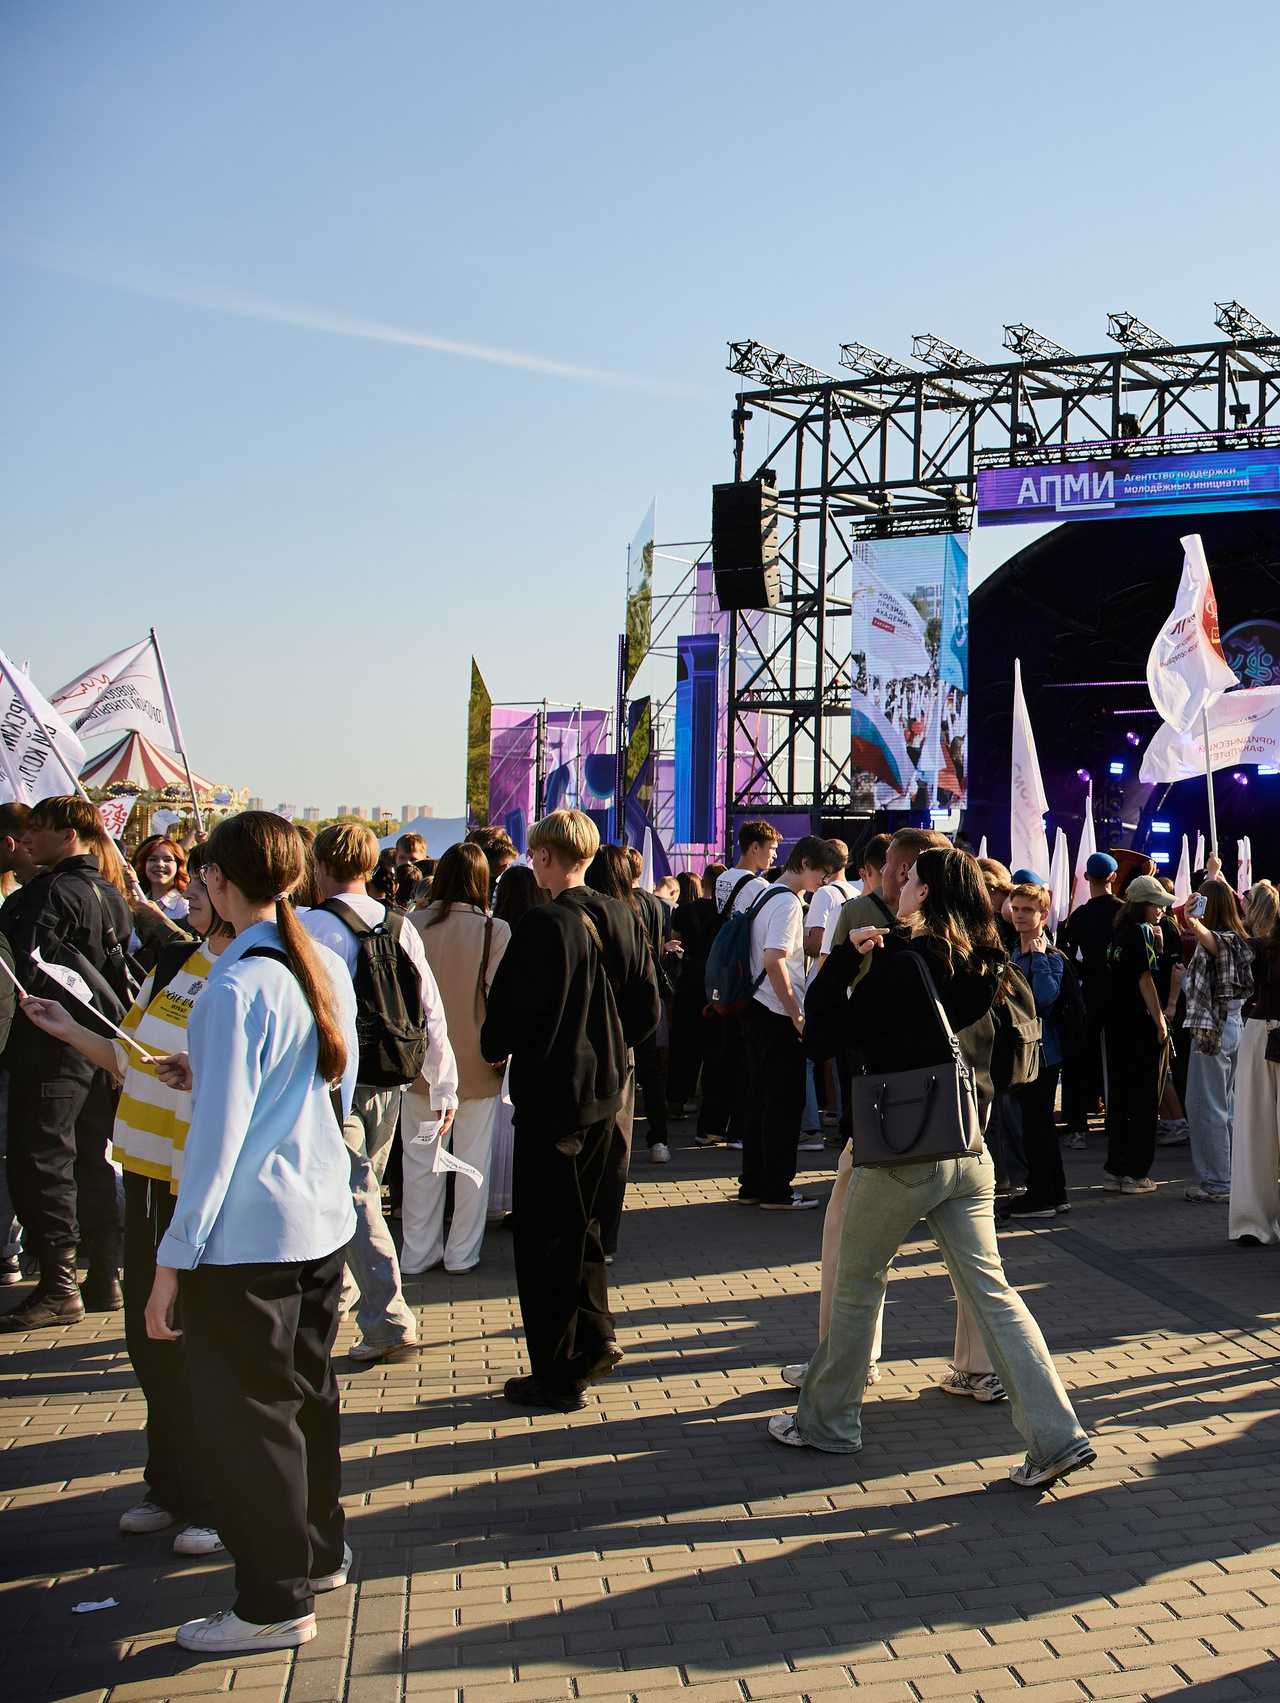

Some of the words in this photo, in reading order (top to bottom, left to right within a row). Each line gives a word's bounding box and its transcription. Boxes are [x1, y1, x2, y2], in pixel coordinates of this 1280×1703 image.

[1124, 472, 1175, 482] Агентство
[1178, 468, 1236, 479] поддержки
[1017, 471, 1115, 512] АПМИ
[1124, 483, 1191, 494] молодёжных
[1194, 479, 1249, 489] инициатив
